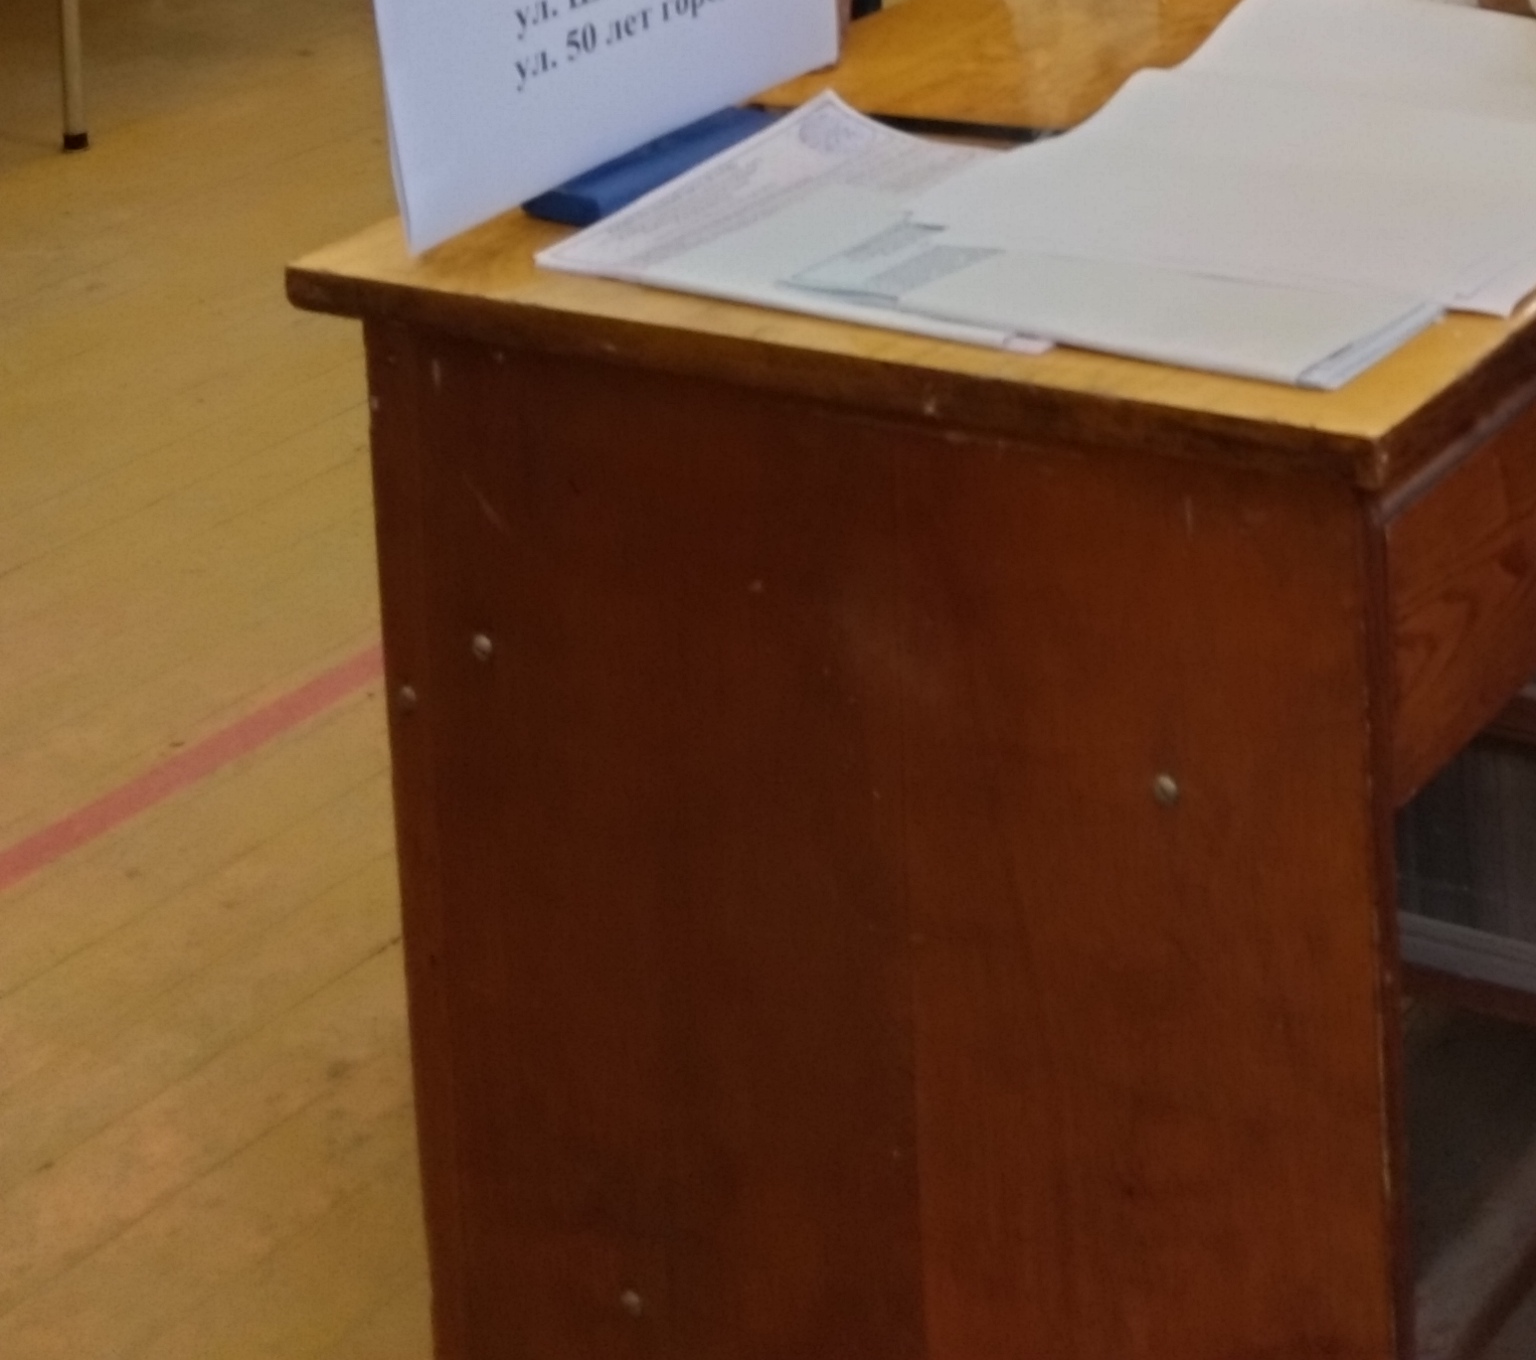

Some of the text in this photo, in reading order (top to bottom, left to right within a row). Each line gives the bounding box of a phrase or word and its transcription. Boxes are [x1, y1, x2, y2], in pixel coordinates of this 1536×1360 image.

[514, 0, 558, 42] ул.
[514, 50, 558, 93] ул.
[565, 23, 598, 60] 50
[605, 9, 650, 46] лет
